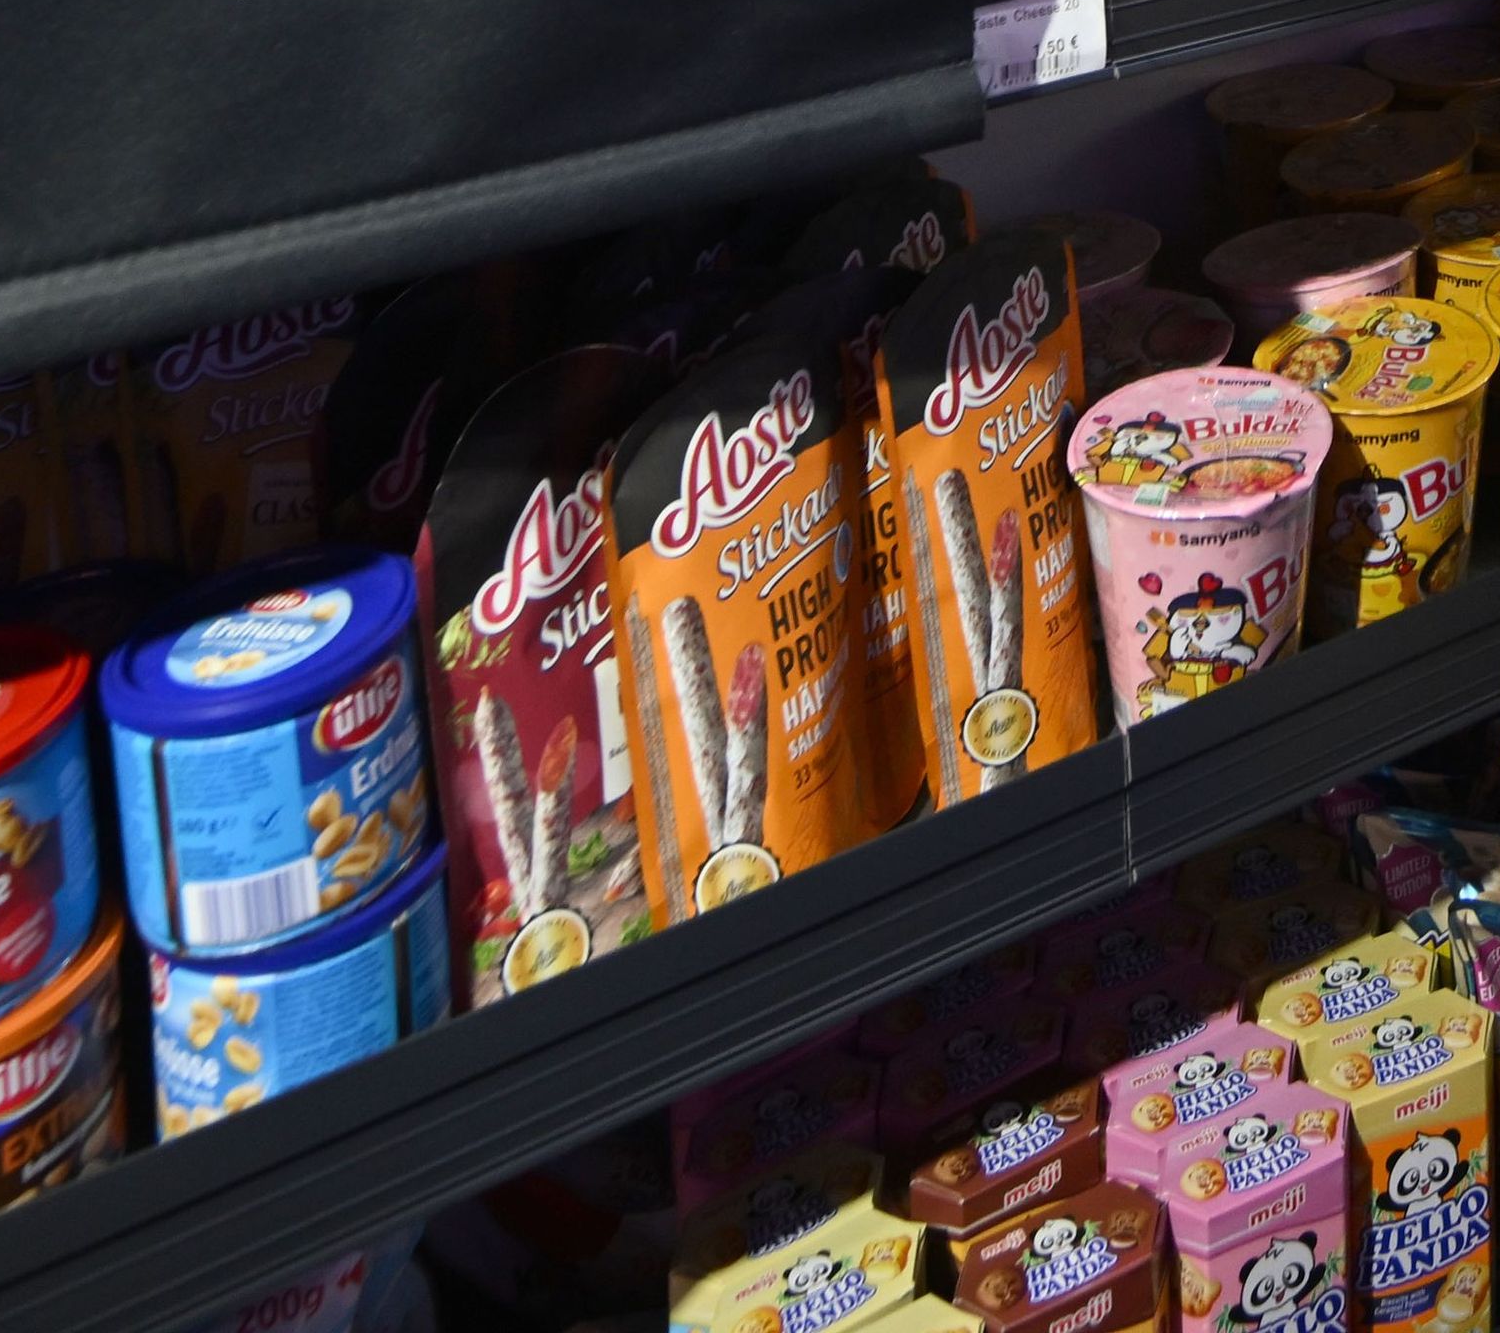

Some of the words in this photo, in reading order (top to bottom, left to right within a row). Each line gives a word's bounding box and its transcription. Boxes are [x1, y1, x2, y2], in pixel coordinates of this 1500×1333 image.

[1013, 3, 1060, 23] Cheese
[925, 267, 1050, 435] Aoste
[1217, 377, 1271, 389] Samyang
[1184, 414, 1305, 443] Buldak
[651, 369, 815, 557] Aoste
[1178, 524, 1261, 548] Samyang
[769, 569, 831, 640] HIGH
[331, 665, 403, 742] ültje
[1322, 975, 1391, 1010] HELLO
[1325, 986, 1399, 1023] PANDA
[1373, 1036, 1442, 1071] HELLO
[1376, 1047, 1453, 1086] PANDA
[1177, 1071, 1247, 1112] HELLO
[1179, 1083, 1257, 1126] PANDA
[1395, 1084, 1449, 1123] meiji
[980, 1113, 1055, 1160] HELLO
[983, 1124, 1065, 1176] PANDA
[1225, 1133, 1299, 1178] HELLO
[1004, 1160, 1063, 1210] meiji
[1229, 1146, 1308, 1192] PANDA
[1248, 1183, 1307, 1229] meiji
[1368, 1184, 1490, 1255] HELLO
[1028, 1236, 1109, 1289] HELLO
[1361, 1217, 1491, 1291] PANDA
[782, 1268, 867, 1325] HELLO
[1031, 1251, 1117, 1304] PANDA
[1050, 1290, 1114, 1333] meiji
